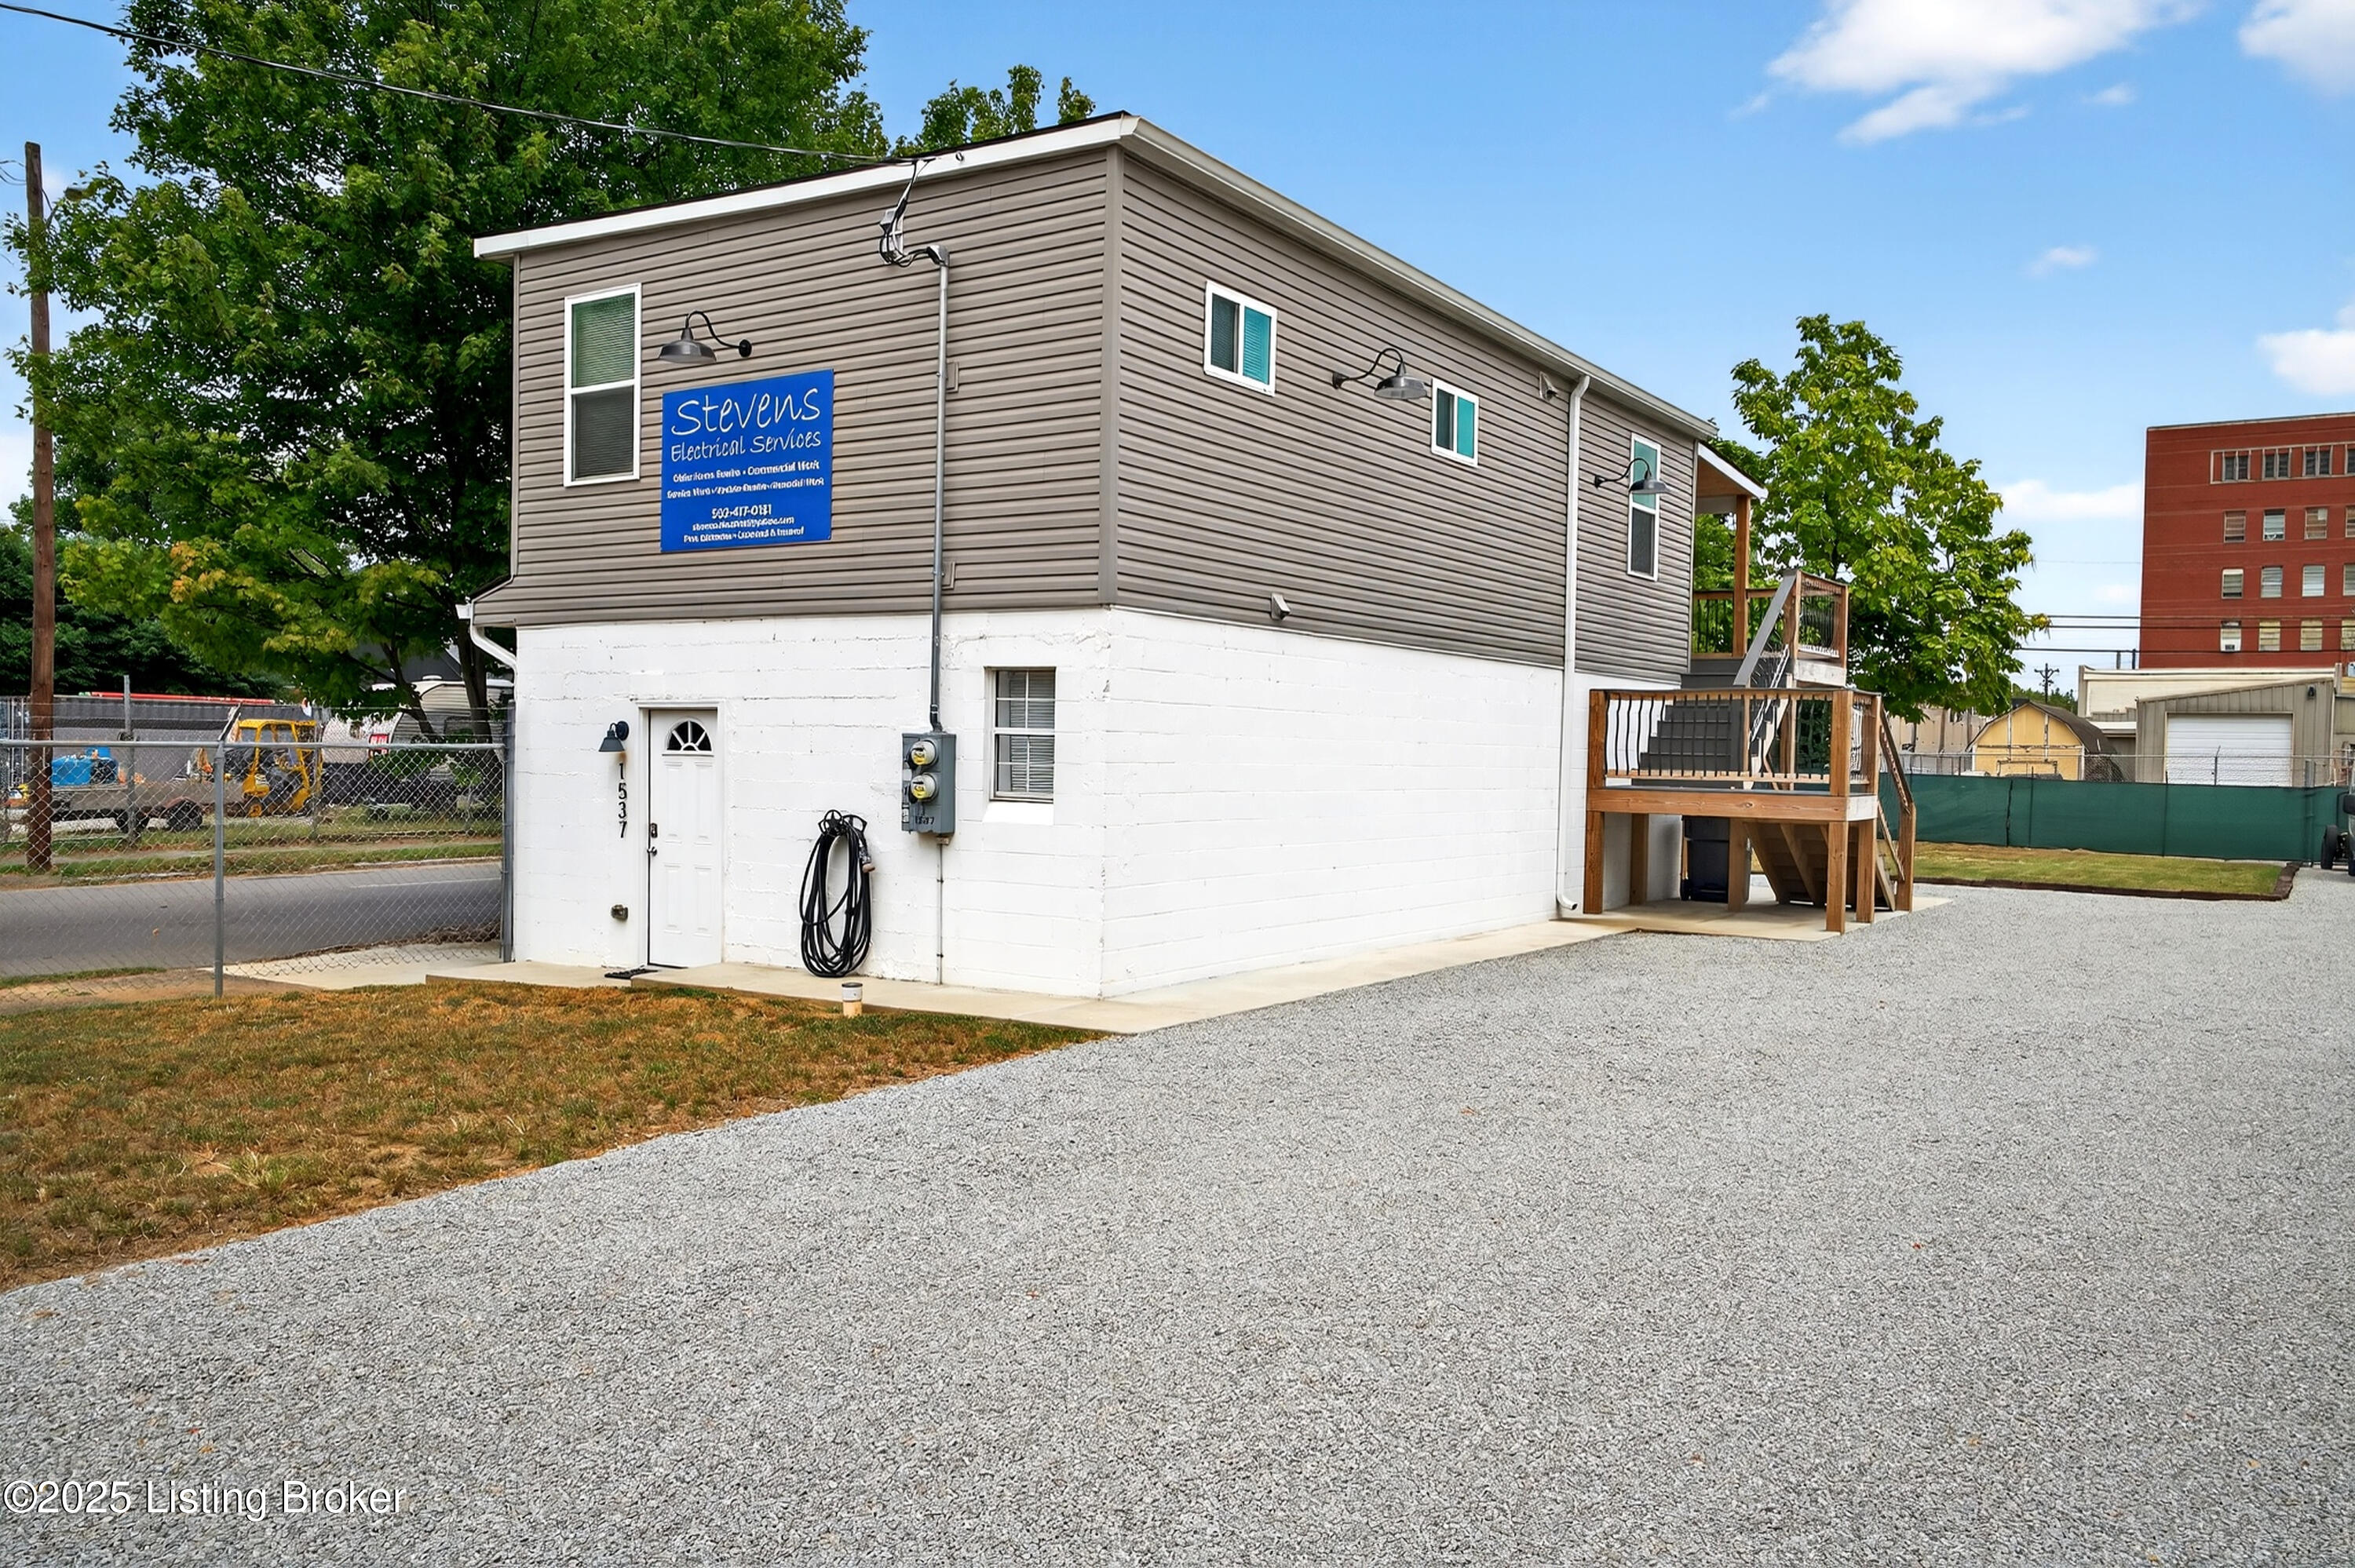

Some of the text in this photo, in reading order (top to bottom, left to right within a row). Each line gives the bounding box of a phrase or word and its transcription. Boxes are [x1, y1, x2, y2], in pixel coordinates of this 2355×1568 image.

[671, 388, 820, 436] Stevens
[671, 428, 821, 462] Electrical Services
[618, 763, 628, 839] 1537
